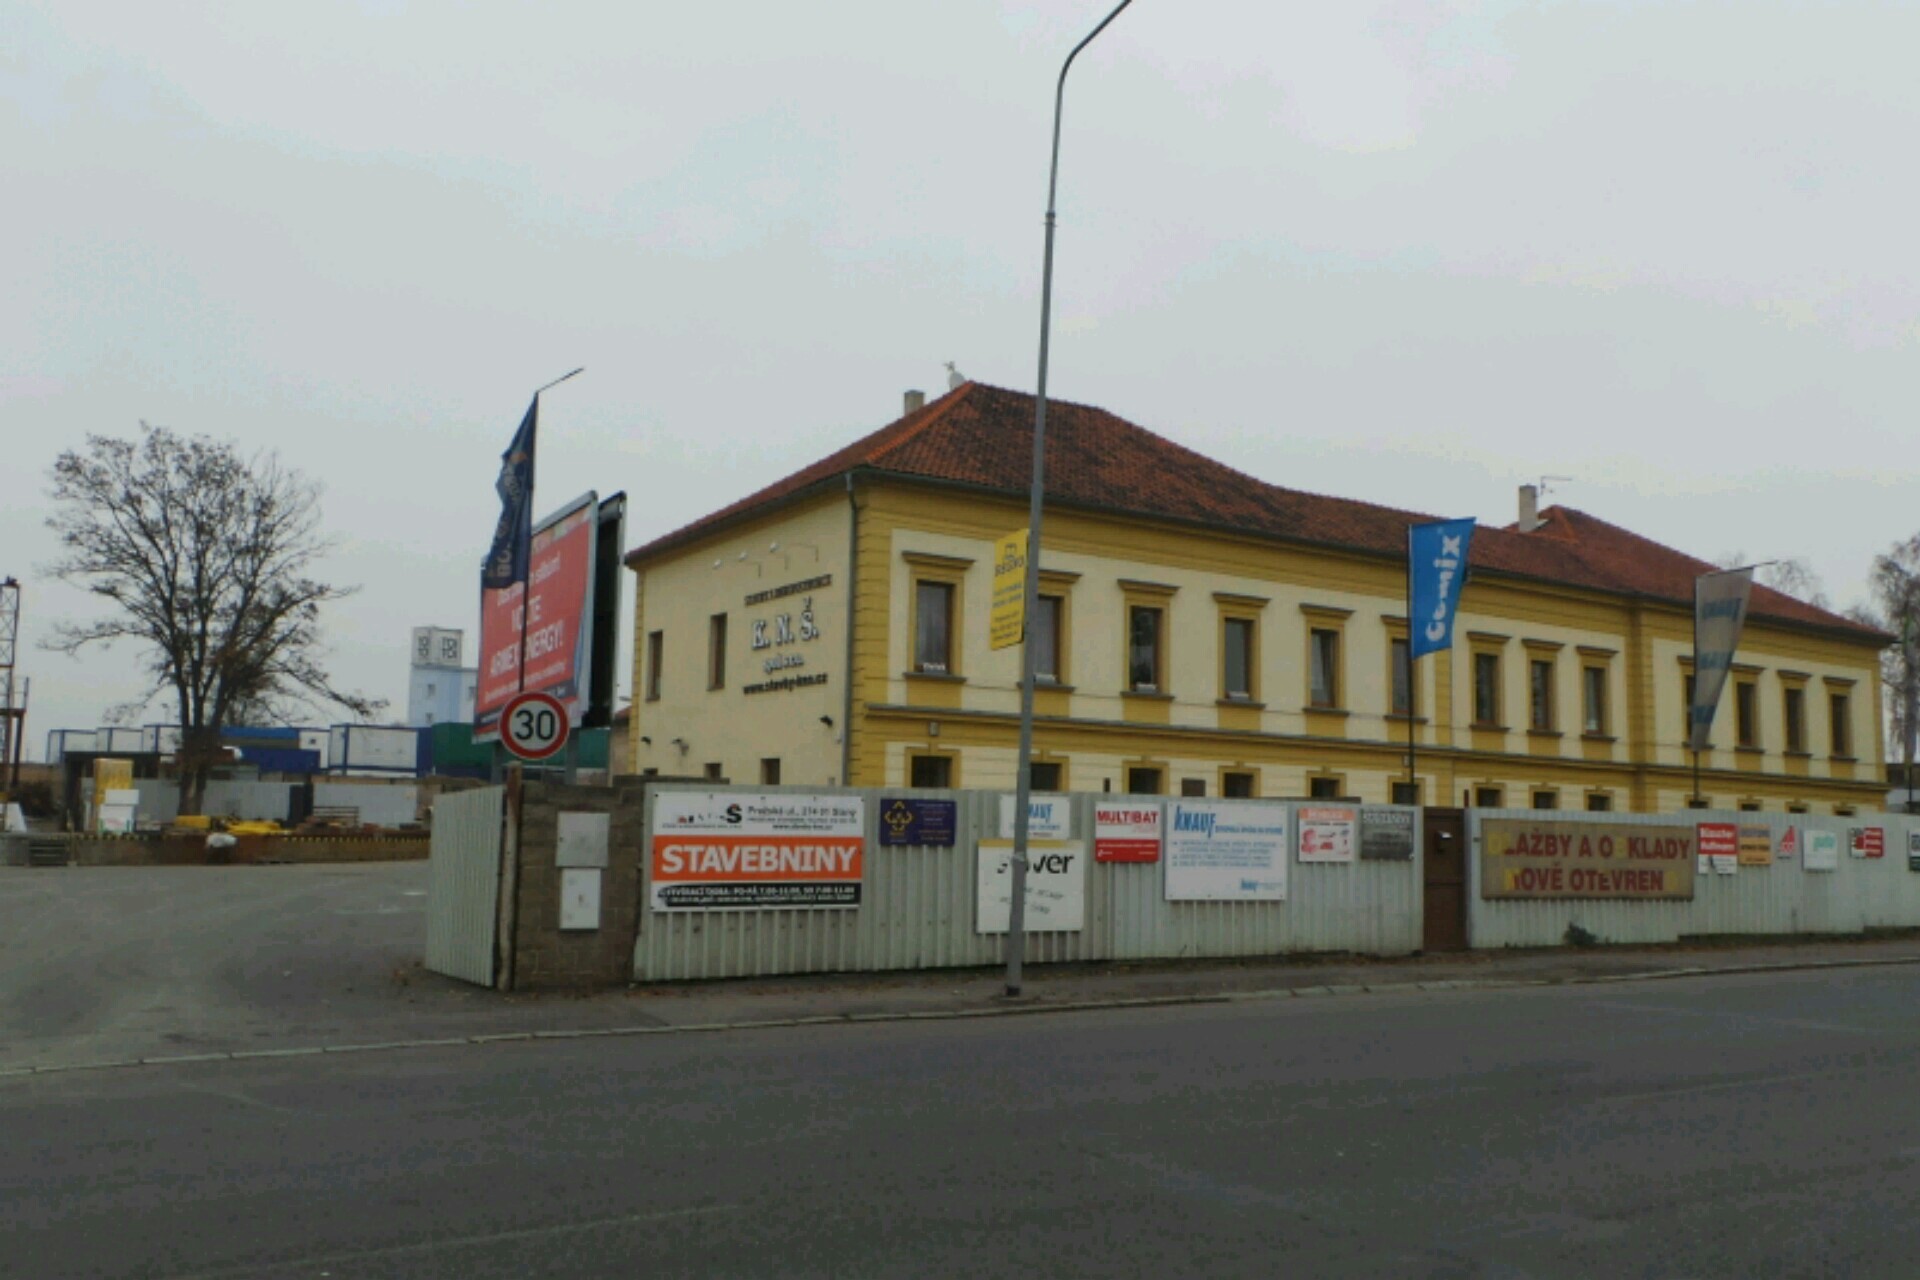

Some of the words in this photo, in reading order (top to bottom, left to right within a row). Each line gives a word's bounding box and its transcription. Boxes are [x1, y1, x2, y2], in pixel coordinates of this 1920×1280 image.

[514, 710, 556, 740] 30
[1028, 803, 1053, 823] NAUF
[1097, 810, 1159, 824] MULTIBAT
[1488, 827, 1573, 857] AŽBY
[1579, 835, 1593, 857] A
[1598, 836, 1690, 859] OKLADY
[661, 844, 857, 873] STAVEBNINY
